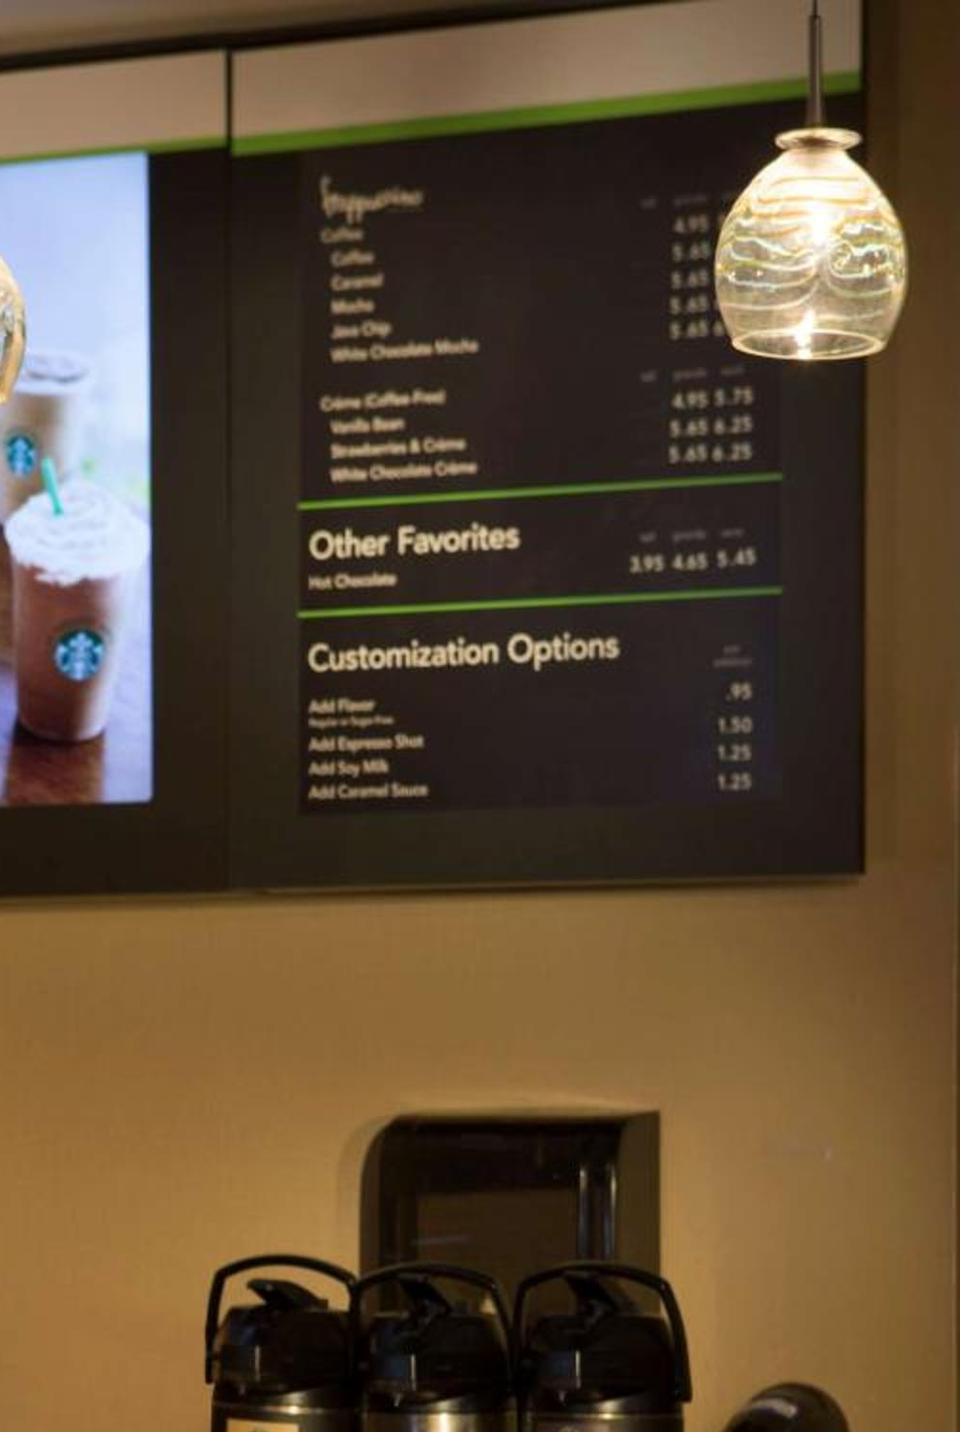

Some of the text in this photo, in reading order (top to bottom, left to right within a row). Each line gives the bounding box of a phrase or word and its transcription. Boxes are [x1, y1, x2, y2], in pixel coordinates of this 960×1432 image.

[308, 521, 521, 562] Other Favorites
[308, 631, 621, 673] Customization Options
[308, 699, 336, 714] Add
[717, 715, 753, 734] 1.50
[308, 735, 336, 752] Add
[394, 731, 425, 750] Shot
[717, 743, 753, 762] 1.25
[308, 759, 336, 776] Add
[337, 759, 361, 779] Soy
[717, 770, 753, 791] 1.25
[308, 783, 336, 800] Add
